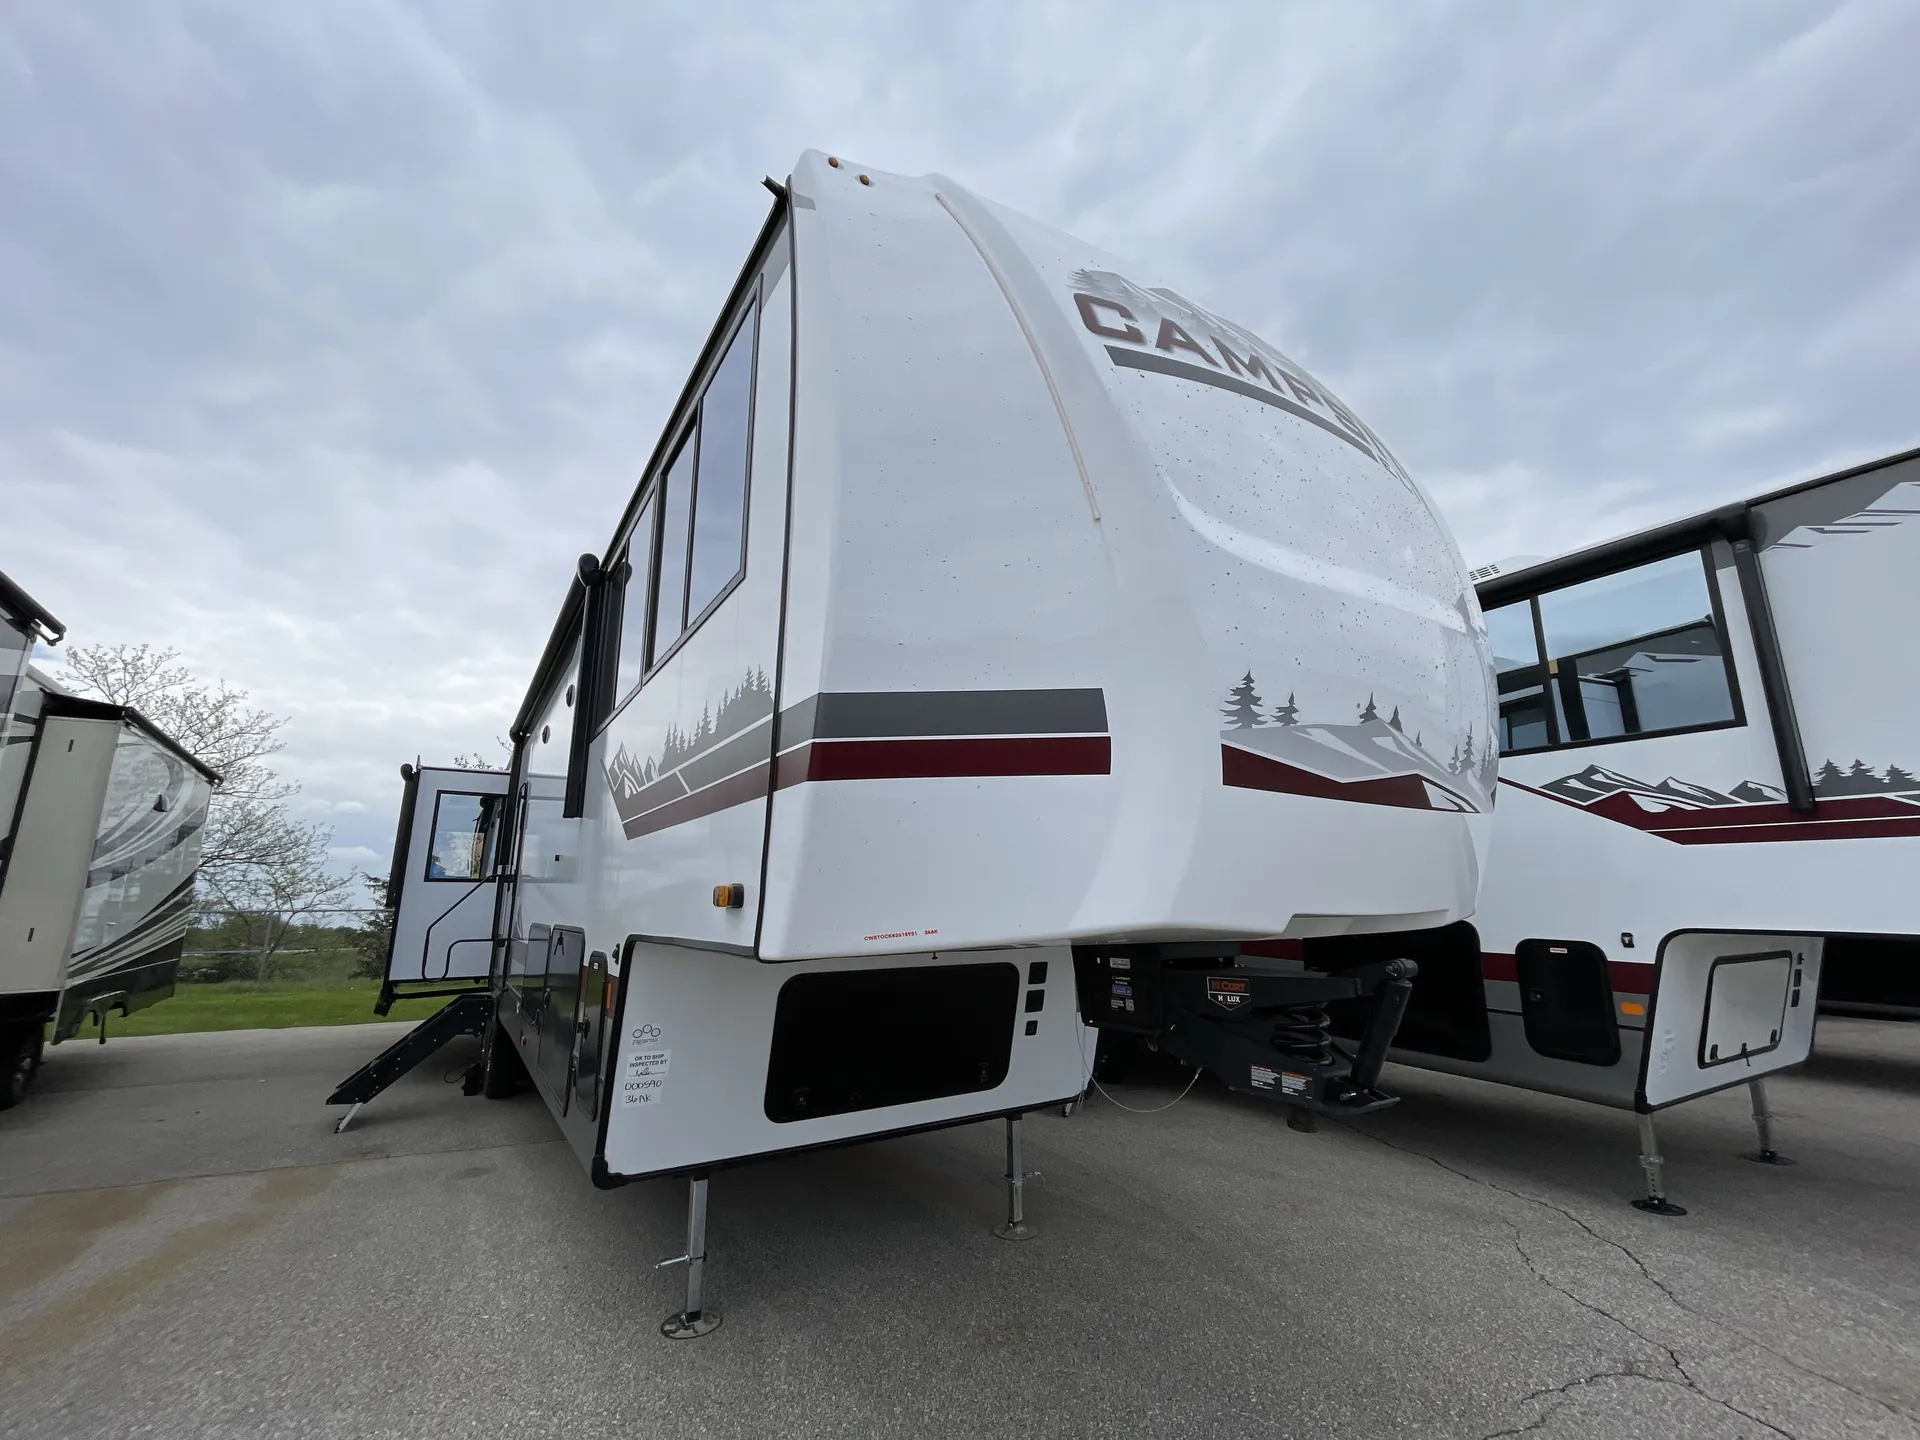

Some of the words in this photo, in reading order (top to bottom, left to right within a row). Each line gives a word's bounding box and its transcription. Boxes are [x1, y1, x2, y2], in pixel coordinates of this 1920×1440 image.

[1218, 994, 1241, 1003] HLUX
[629, 1060, 659, 1068] INSPECTED
[625, 1094, 652, 1104] 36AK
